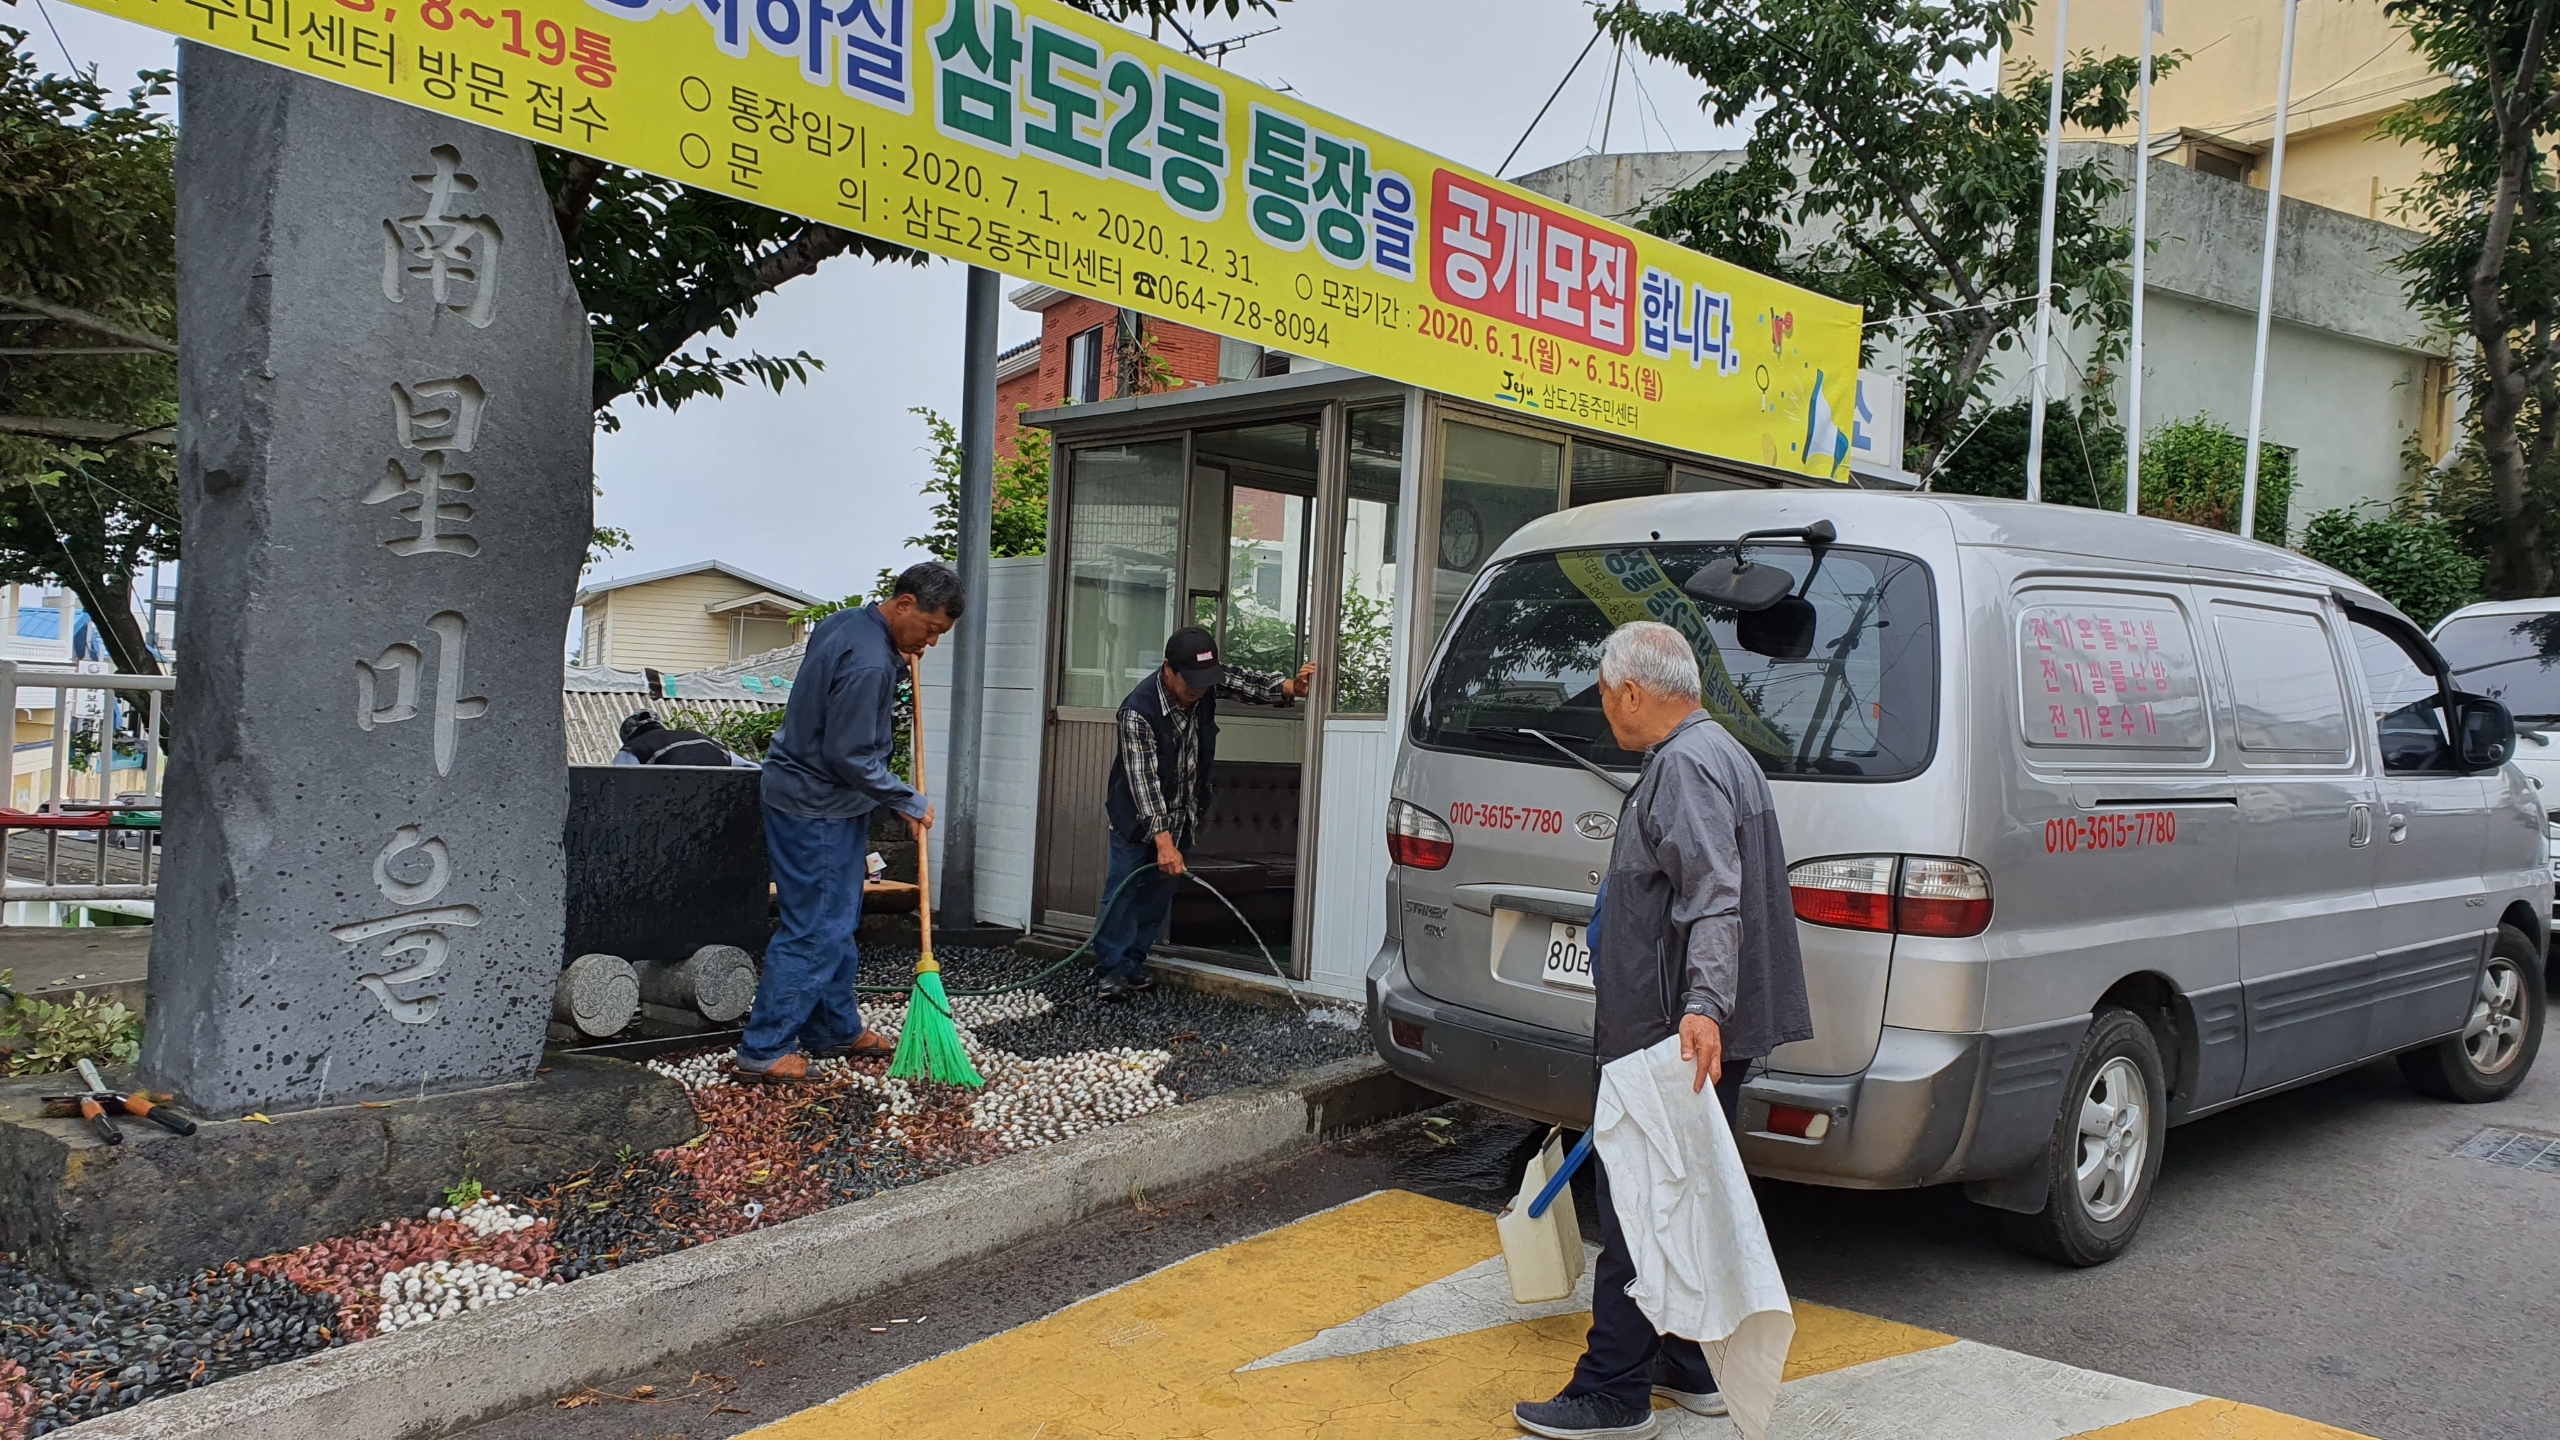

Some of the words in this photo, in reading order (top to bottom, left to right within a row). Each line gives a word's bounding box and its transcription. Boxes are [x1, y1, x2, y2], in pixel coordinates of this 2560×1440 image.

[418, 45, 509, 116] 방문
[525, 78, 609, 144] 접수
[727, 85, 866, 169] 통장임기
[902, 144, 989, 203] 2020.
[1002, 176, 1026, 215] 7.
[1037, 189, 1061, 226] 1.
[1098, 208, 1169, 259] 2020.
[1179, 235, 1215, 274] 12.
[1225, 248, 1260, 287] 31.
[934, 0, 1224, 213] 삼도2동
[1248, 108, 1415, 274] 통장을
[1442, 184, 1627, 347] 공개모집
[1642, 271, 1738, 370] 합니다.
[901, 194, 1122, 296] 삼도2동주민센터
[1158, 275, 1330, 349] 064-728-8094
[1321, 277, 1400, 330] 모집기간
[1418, 305, 1478, 351] 2020.
[1486, 326, 1504, 358] 6.
[1586, 353, 1602, 387] 6.
[1542, 385, 1640, 431] 삼도2동주민센터
[2048, 702, 2157, 740] 전기온수기
[1450, 801, 1563, 835] 010-3615-7780
[2045, 810, 2176, 854] 010-3615-7780
[1404, 899, 1448, 921] STAREX
